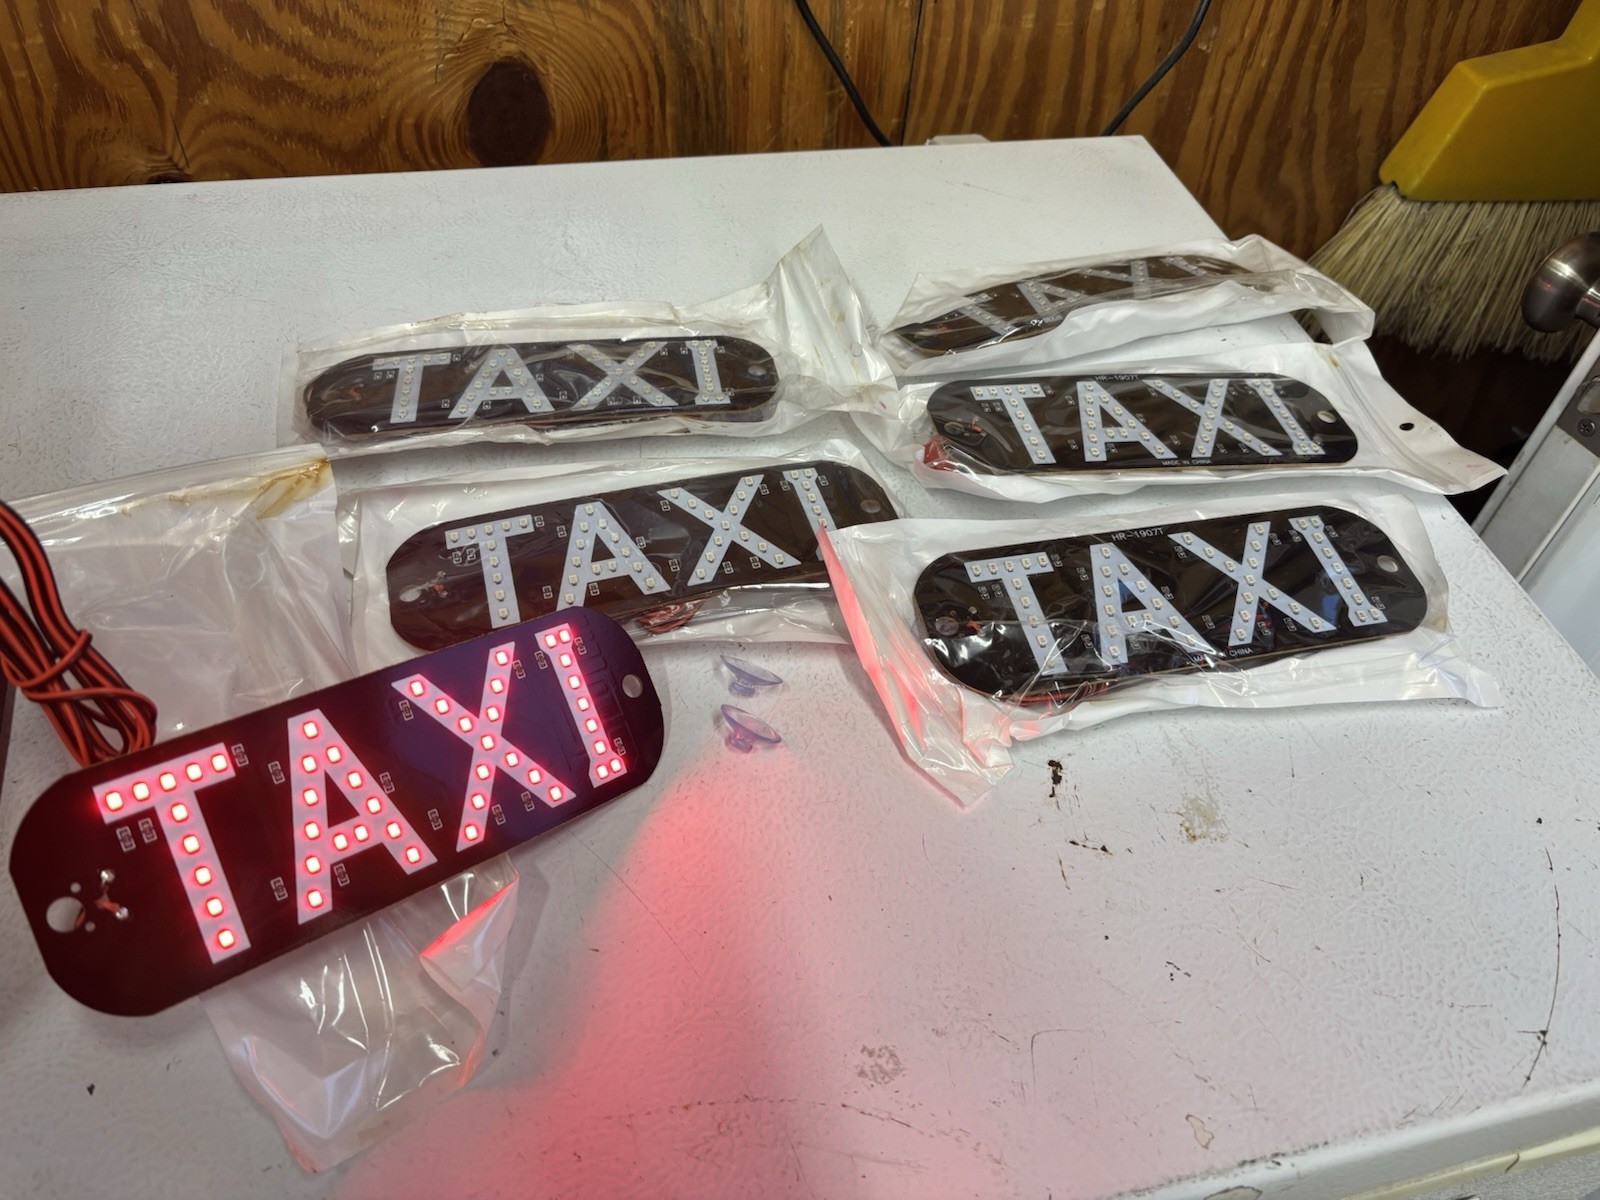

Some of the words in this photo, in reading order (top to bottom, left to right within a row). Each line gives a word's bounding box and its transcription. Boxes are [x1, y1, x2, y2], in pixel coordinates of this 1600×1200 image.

[372, 340, 731, 424] TAXI
[970, 379, 1325, 463] TAXI
[445, 468, 838, 629] TAXI
[1111, 527, 1164, 541] HR-1907T
[964, 516, 1387, 674] TAXI
[1229, 647, 1254, 657] CHINA
[92, 623, 627, 963] TAXI
